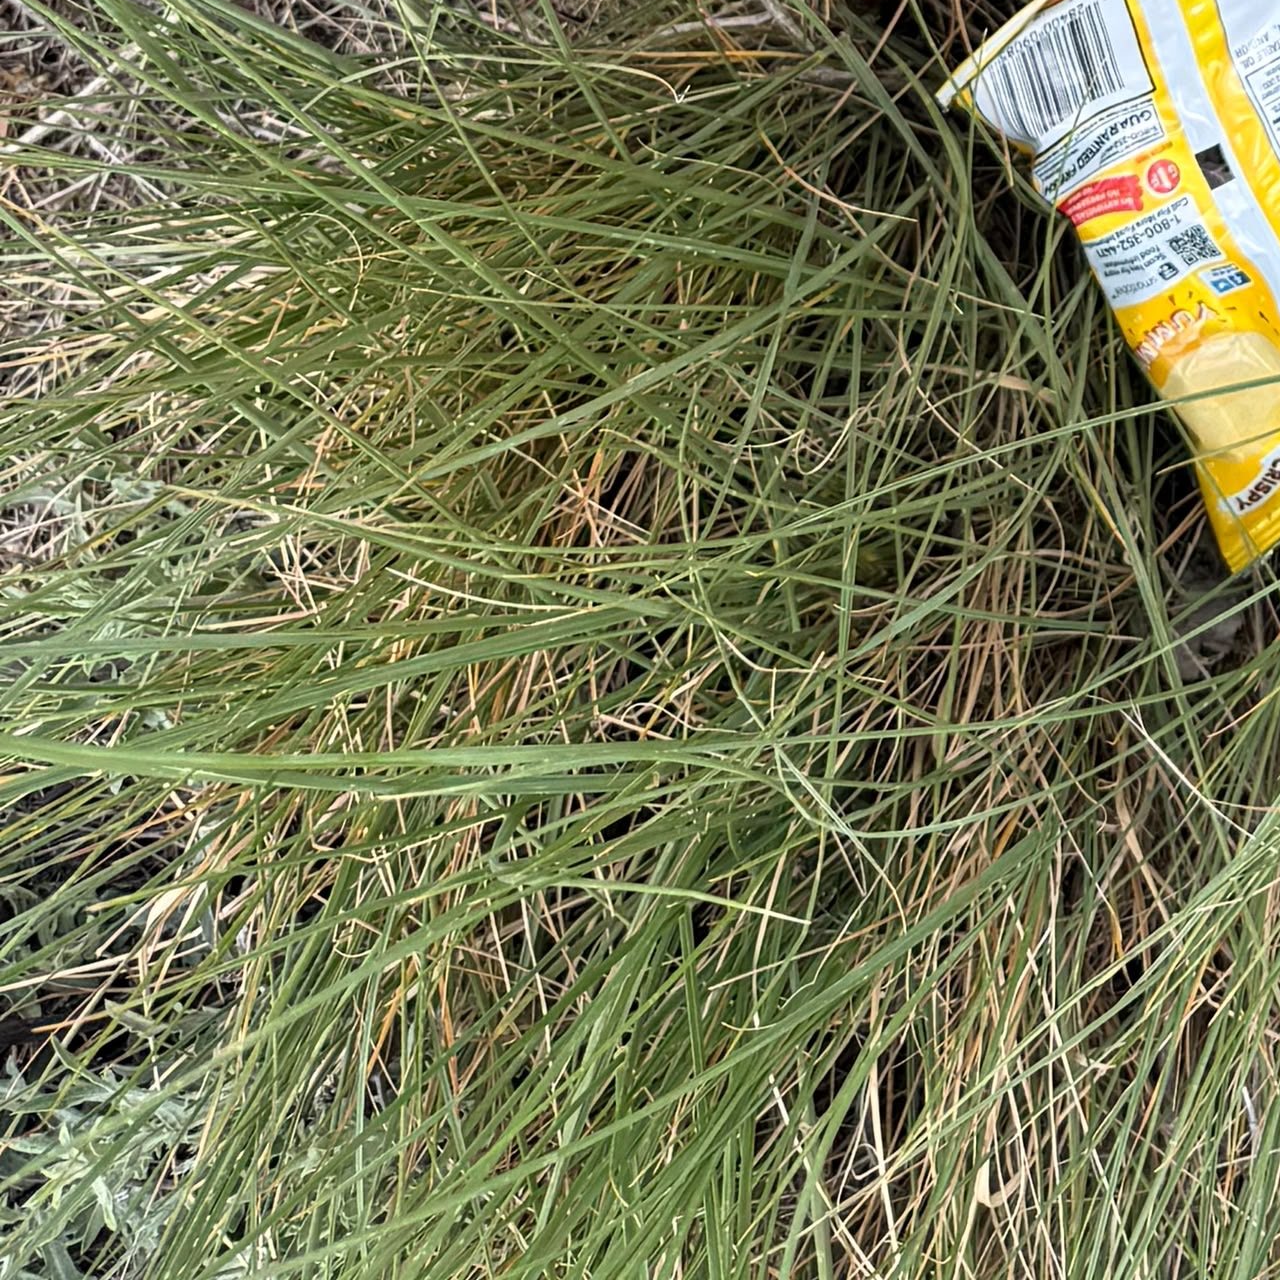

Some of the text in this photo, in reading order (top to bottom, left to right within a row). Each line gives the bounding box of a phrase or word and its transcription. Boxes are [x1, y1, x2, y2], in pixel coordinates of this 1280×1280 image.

[1075, 107, 1153, 169] GUARANTEED
[1169, 196, 1189, 210] Call
[1095, 212, 1181, 259] 1-800-352-4477
[1136, 243, 1160, 257] food
[1142, 251, 1167, 269] Scan
[1131, 300, 1219, 372] YUMM
